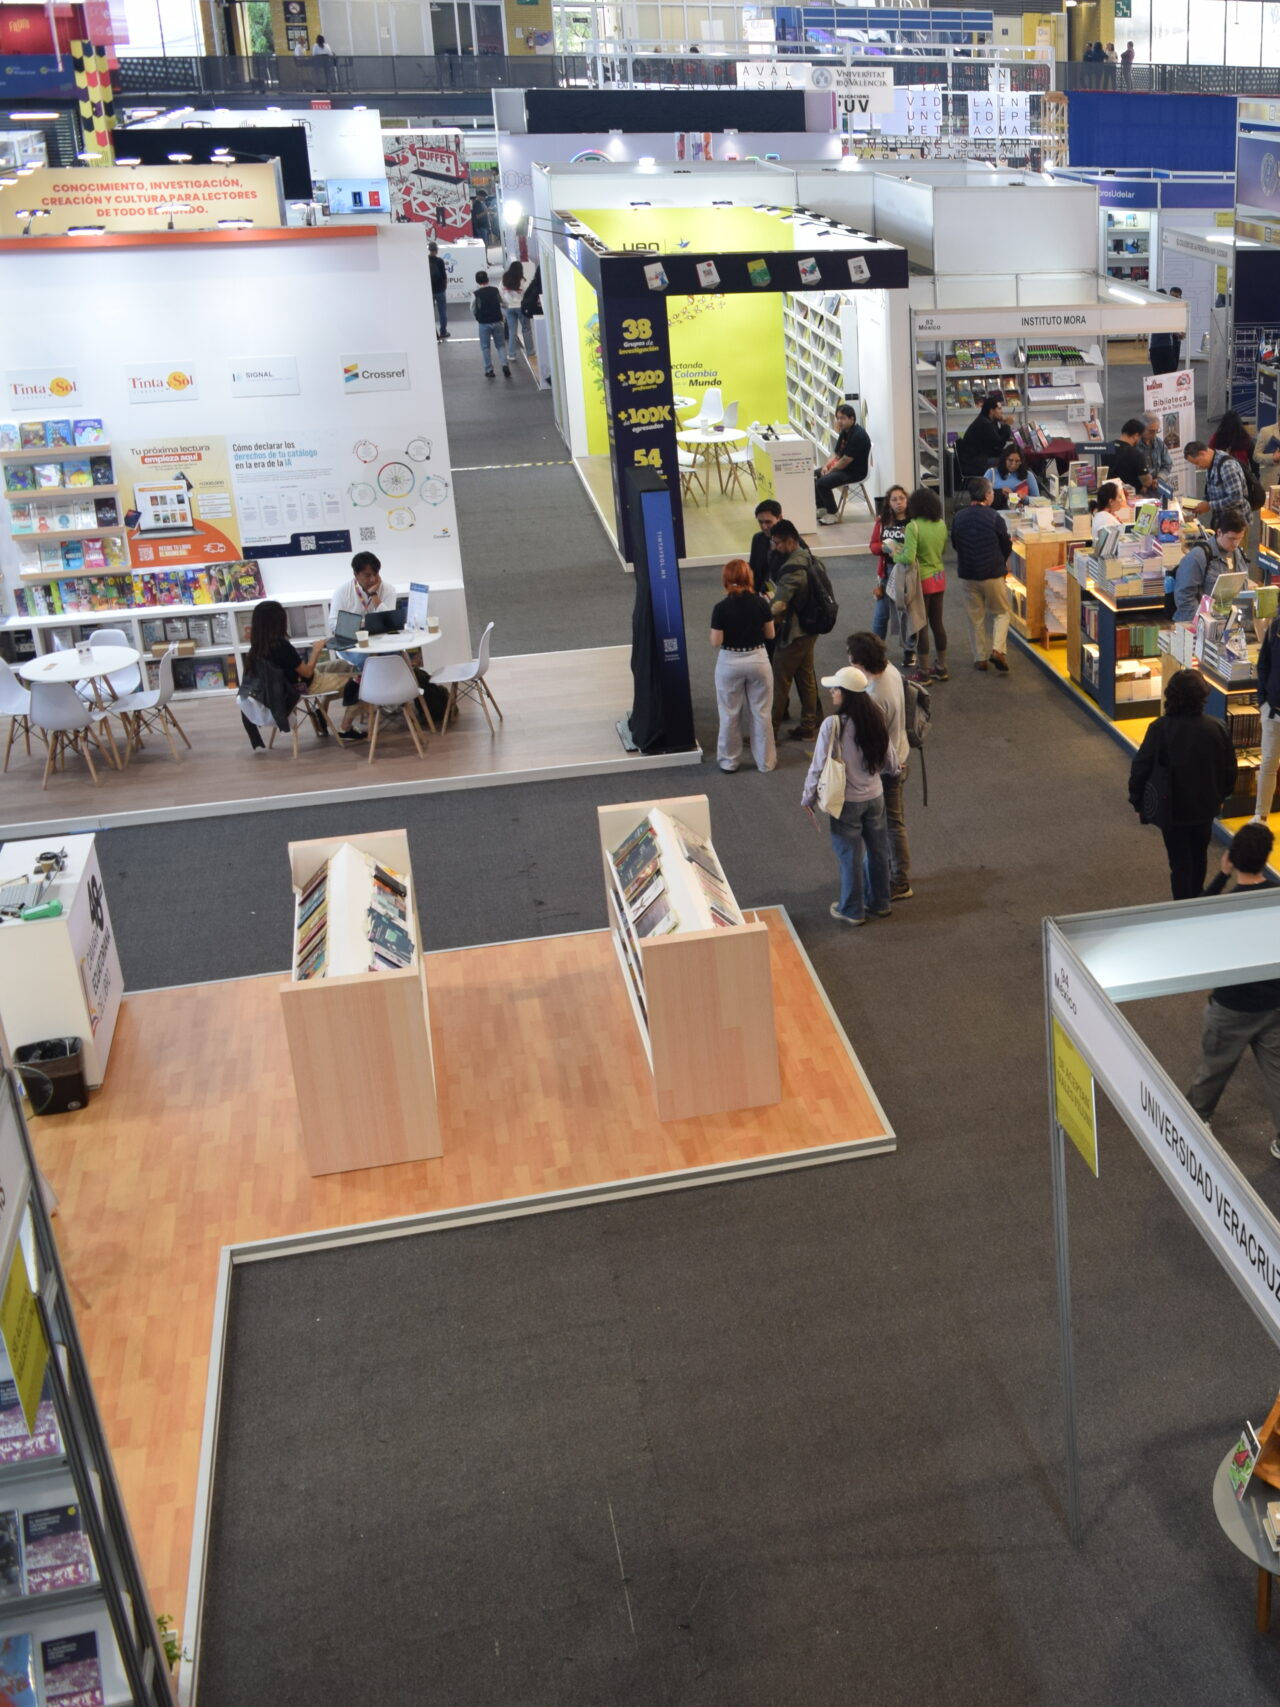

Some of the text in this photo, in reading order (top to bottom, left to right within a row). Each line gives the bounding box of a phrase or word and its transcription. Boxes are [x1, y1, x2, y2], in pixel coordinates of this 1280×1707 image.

[838, 100, 869, 112] UV
[418, 151, 453, 165] BUFFET
[52, 177, 243, 194] CONOCIMIENTO, INVESTIGACIÓN,
[41, 190, 258, 207] CREACIÓN Y CULTURA PARA LECTORES
[96, 207, 110, 218] DE
[113, 206, 146, 217] TODO
[1021, 315, 1086, 326] INSTITUTO MORA
[621, 318, 652, 341] 38
[918, 323, 941, 331] México
[619, 345, 659, 355] investigación
[623, 341, 645, 349] Grupos
[671, 361, 703, 370] ectando
[245, 371, 273, 379] SIGNAL
[362, 368, 405, 380] Crossref
[617, 370, 665, 387] +1200
[674, 369, 718, 378] Colombia
[129, 376, 164, 389] Tinta
[173, 375, 194, 387] Sol
[689, 378, 722, 387] Mundo
[10, 382, 46, 396] Tinta
[55, 381, 77, 393] Sol
[617, 405, 673, 425] +100K
[632, 423, 664, 433] egresados
[130, 444, 210, 456] Tu próxima lectura
[233, 440, 295, 452] Cómo declarar los
[144, 452, 198, 464] empieza aquí
[234, 451, 266, 461] derechos
[268, 451, 276, 459] de
[288, 449, 318, 458] catálogo
[633, 448, 662, 468] 54
[235, 462, 244, 470] en
[246, 460, 252, 469] la
[267, 459, 275, 468] de
[277, 459, 284, 467] la
[1054, 972, 1077, 1016] México
[1139, 1080, 1213, 1204] UNIVERSIDAD
